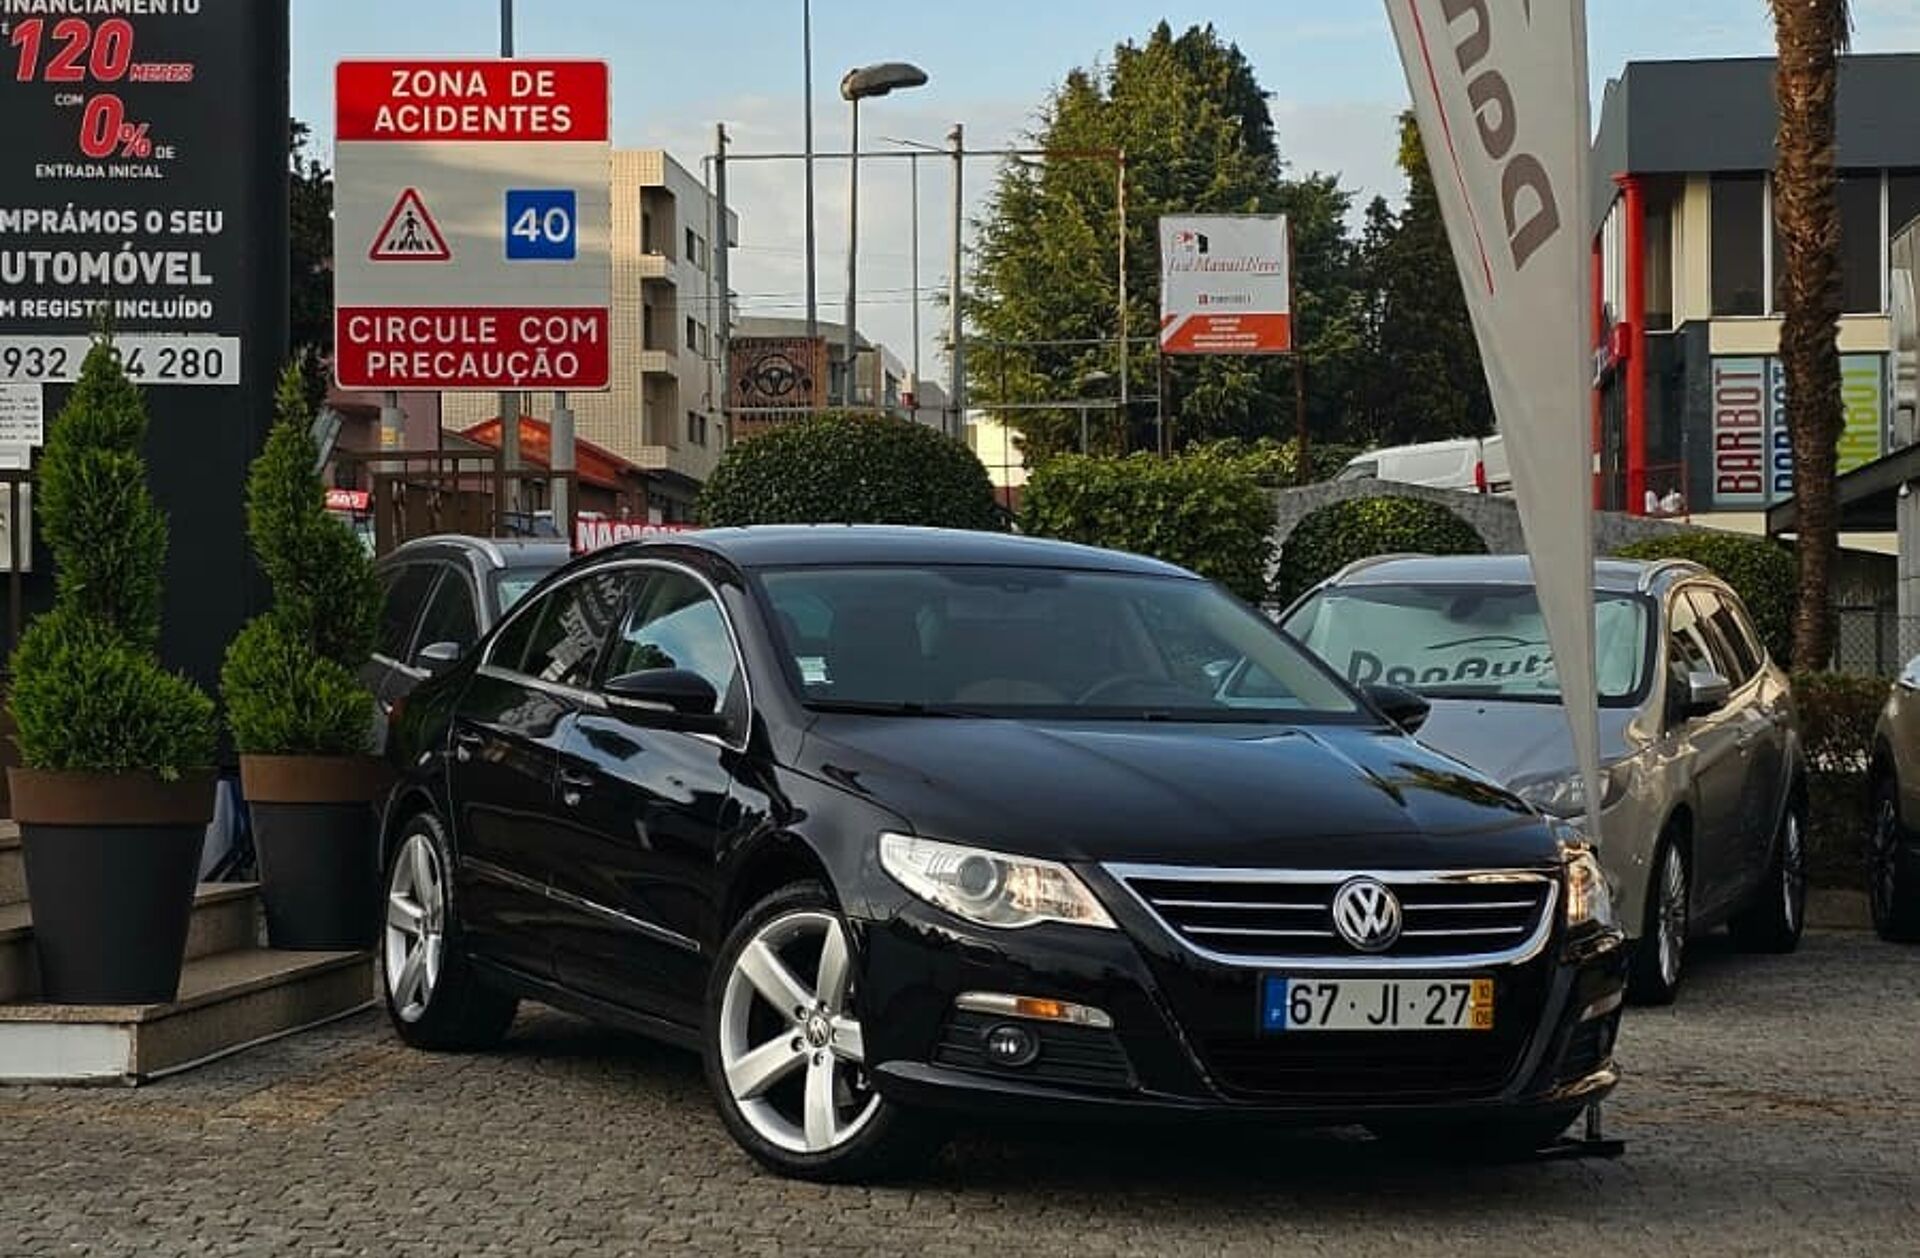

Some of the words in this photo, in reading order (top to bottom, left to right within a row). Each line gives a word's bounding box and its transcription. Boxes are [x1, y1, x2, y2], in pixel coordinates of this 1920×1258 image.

[0, 0, 201, 14] INANCIAMENTO
[11, 18, 134, 82] 120
[391, 70, 488, 98] ZONA
[511, 71, 555, 97] DE
[54, 94, 84, 106] COM
[79, 94, 153, 158] 0%
[156, 147, 176, 159] DE
[374, 105, 572, 132] ACIDENTES
[35, 164, 105, 178] ENTRADA
[109, 164, 164, 178] INICIAL
[145, 211, 163, 234] O
[170, 211, 223, 234] SEU
[511, 207, 570, 243] 40
[0, 242, 213, 285] UTOMÓVEL
[115, 295, 213, 319] INCLUÍDO
[349, 316, 497, 344] CIRCULE
[519, 316, 598, 344] COM
[3, 347, 67, 378] 932
[158, 347, 223, 378] 280
[367, 348, 579, 385] PRECAUÇÃO
[1716, 366, 1763, 494] BARBOT
[1350, 650, 1554, 684] DonAut
